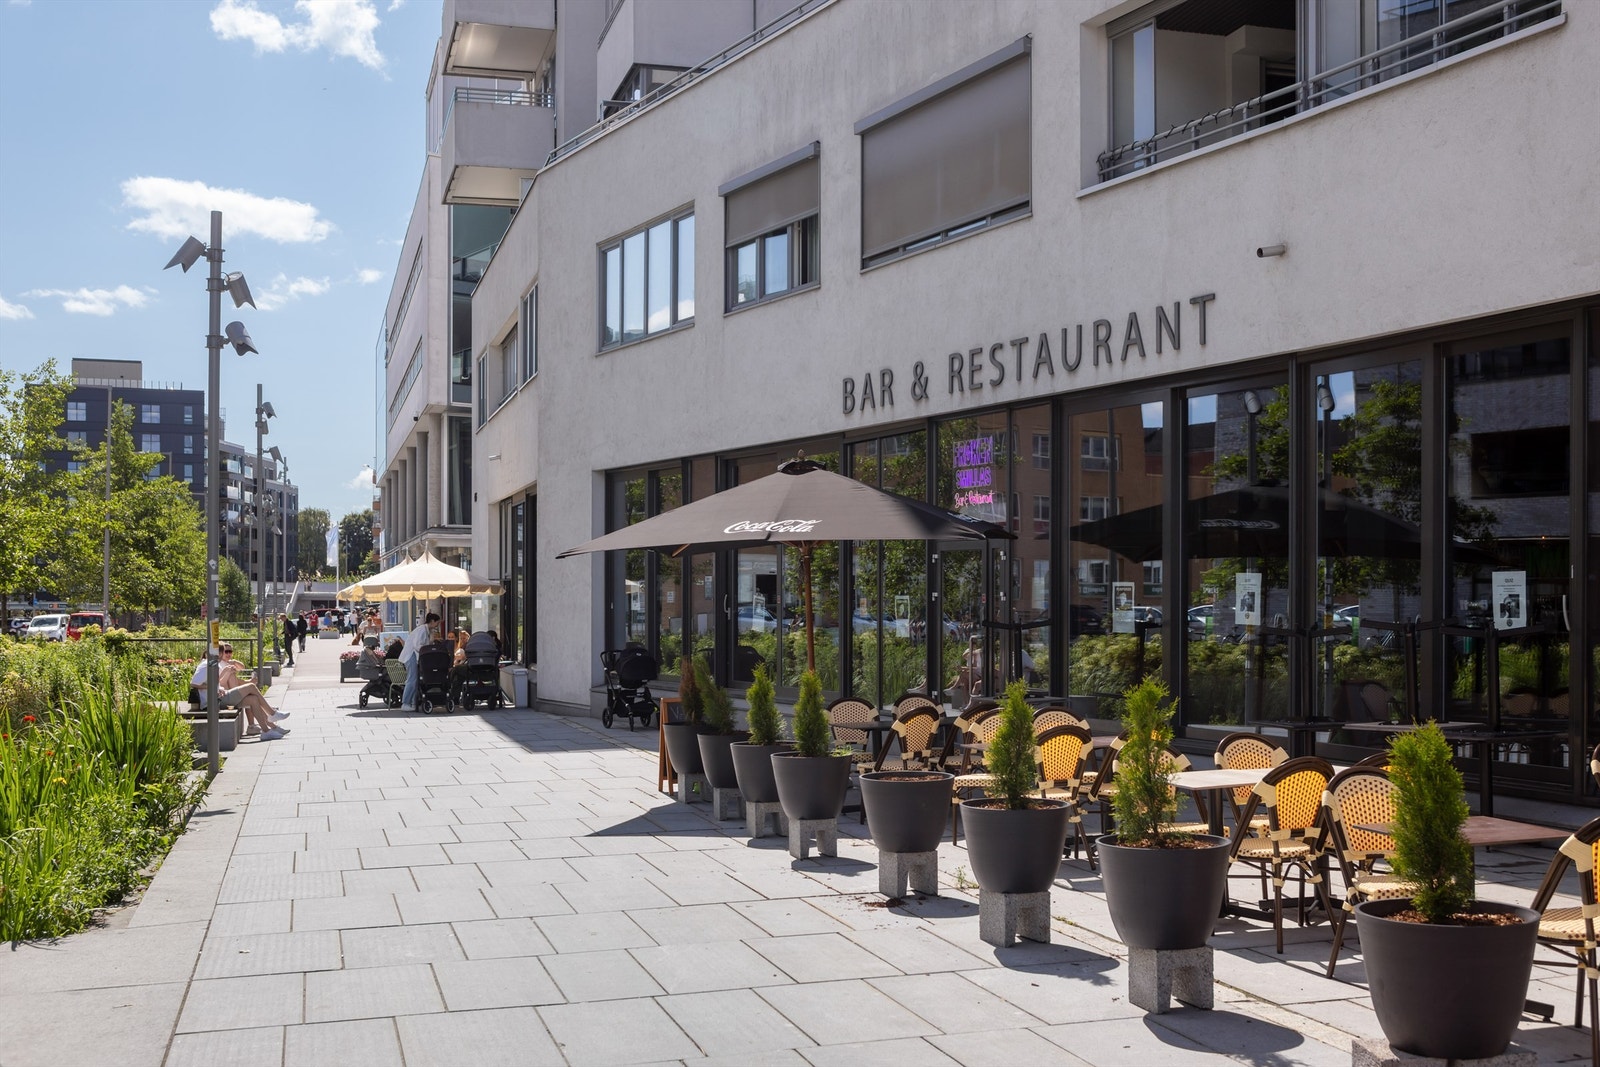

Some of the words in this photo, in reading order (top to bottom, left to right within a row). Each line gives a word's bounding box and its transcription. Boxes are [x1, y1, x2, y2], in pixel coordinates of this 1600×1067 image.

[842, 368, 894, 415] BAR
[911, 360, 929, 401] &
[948, 293, 1216, 394] RESTAURANT
